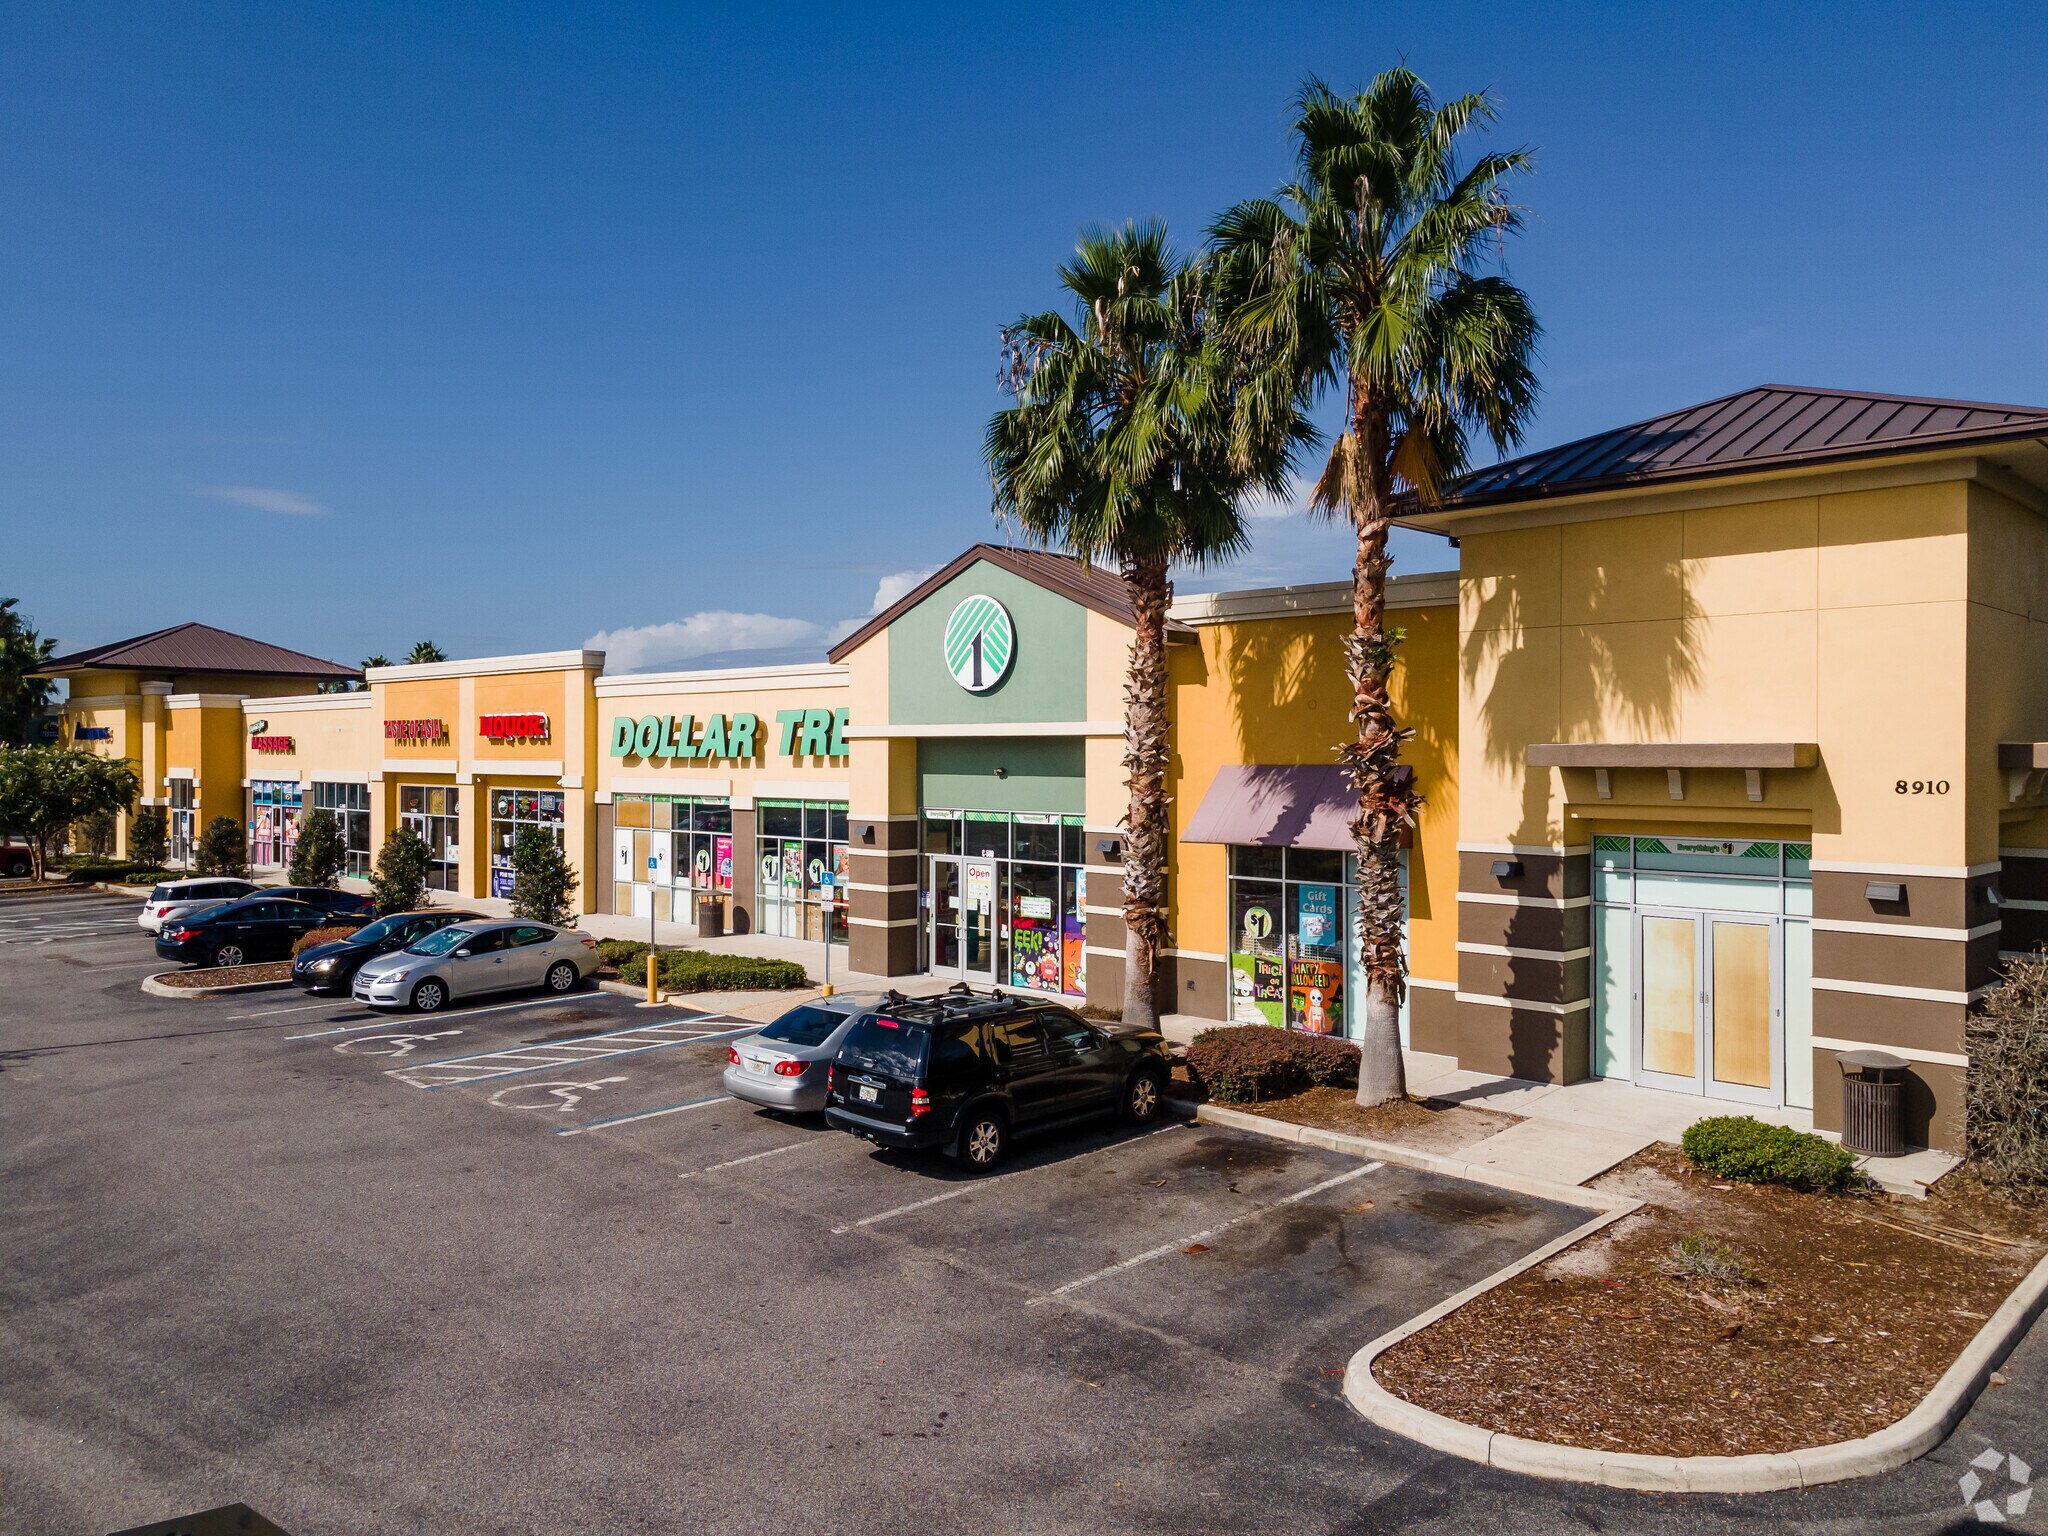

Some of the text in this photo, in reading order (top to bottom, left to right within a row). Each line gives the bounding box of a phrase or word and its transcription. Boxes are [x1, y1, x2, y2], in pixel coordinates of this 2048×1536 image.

[384, 719, 442, 738] TASTE OF ASIA
[479, 714, 547, 740] LIQUOR
[251, 736, 290, 750] MASSAGE
[610, 713, 760, 758] DOLLAR
[1894, 780, 1950, 795] 8910
[621, 850, 627, 865] $1
[699, 855, 706, 871] $1
[765, 861, 772, 878] $1
[812, 865, 820, 881] $1
[969, 868, 990, 879] Open
[1307, 891, 1327, 901] Gift
[1302, 903, 1333, 914] Cards
[1250, 913, 1265, 938] $1
[1015, 929, 1043, 955] EEK!
[1294, 963, 1319, 975] HAPPY
